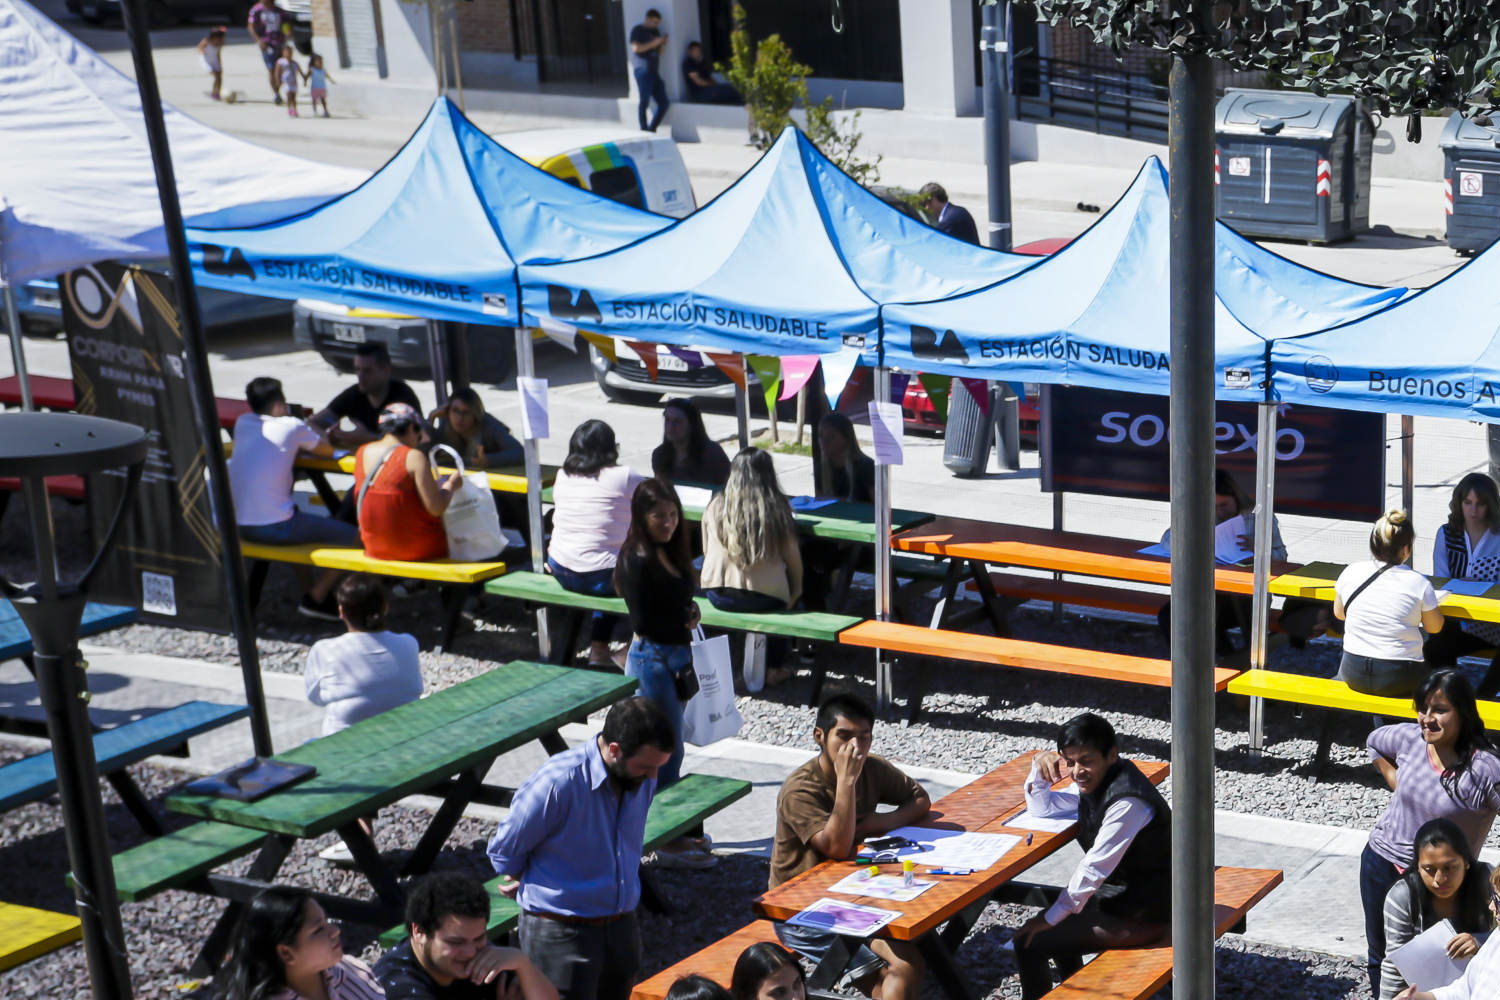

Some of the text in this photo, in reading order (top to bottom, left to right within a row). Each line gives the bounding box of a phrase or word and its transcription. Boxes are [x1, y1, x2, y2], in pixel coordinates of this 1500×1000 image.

[361, 270, 471, 303] SALUDABLE
[613, 299, 707, 325] ESTACIÓN
[715, 308, 829, 340] SALUDABLE
[980, 336, 1080, 361] ESTACIÓN
[1368, 370, 1466, 400] Buenos
[1096, 411, 1305, 461] soexo
